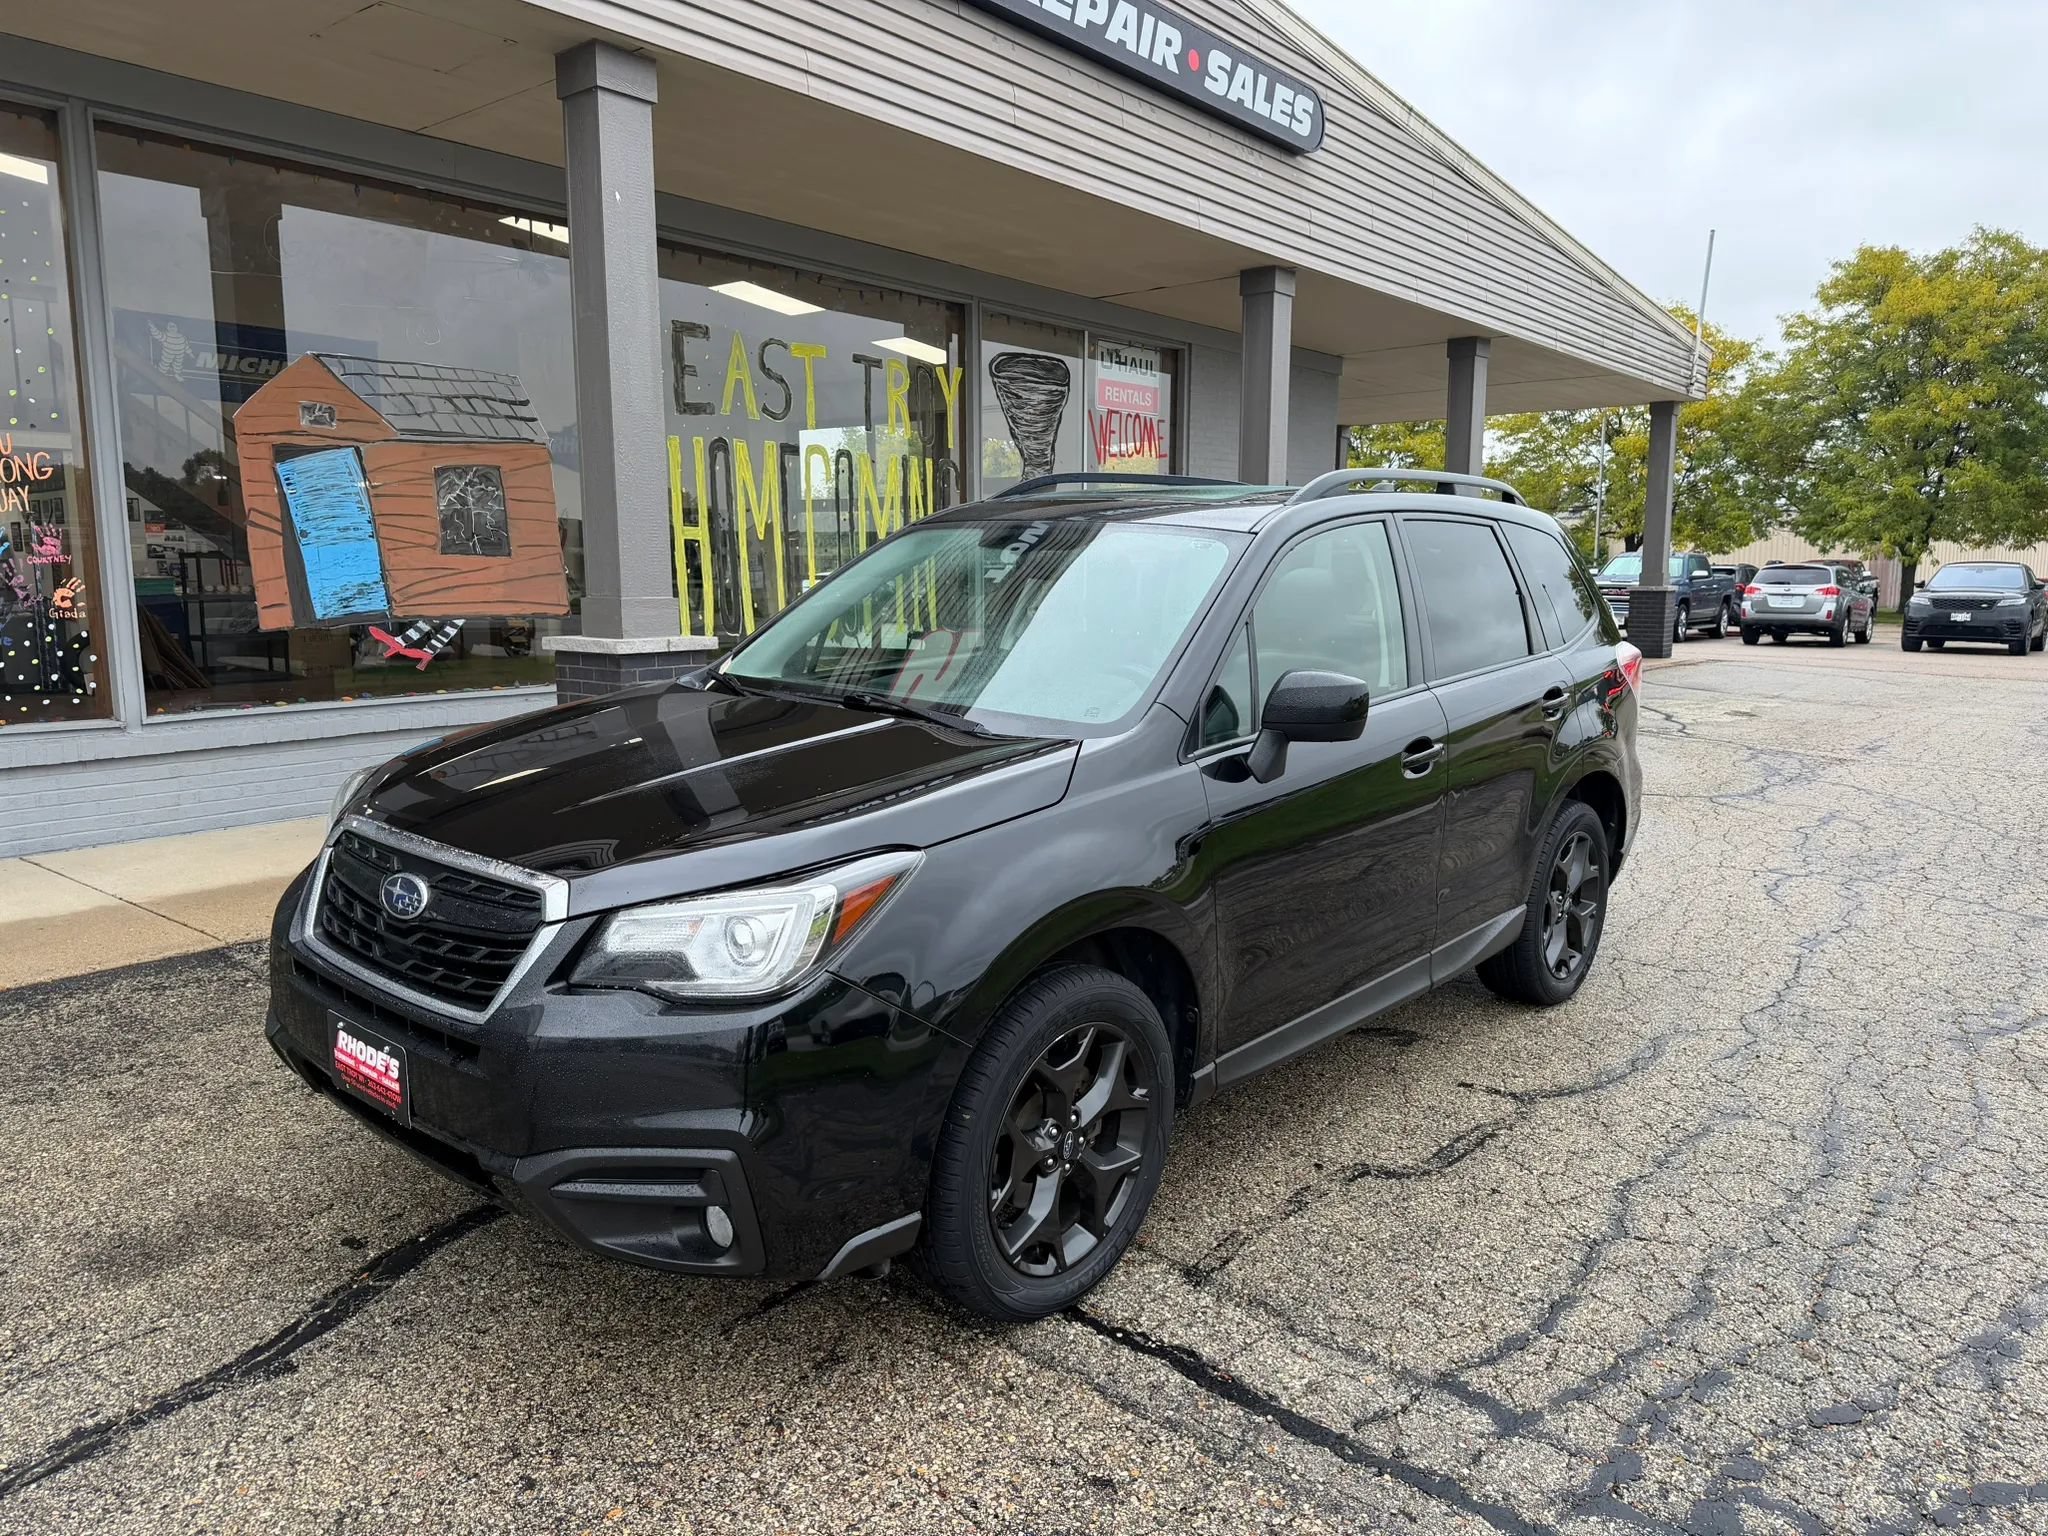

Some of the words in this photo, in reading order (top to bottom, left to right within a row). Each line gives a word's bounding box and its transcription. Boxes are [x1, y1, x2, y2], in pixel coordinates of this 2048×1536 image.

[1027, 0, 1183, 74] PAIR
[1204, 49, 1314, 137] SALES
[671, 319, 827, 430] EAST
[852, 353, 963, 449] TROY
[1105, 386, 1152, 406] RENTALS
[1088, 408, 1168, 465] WELCOME
[26, 554, 72, 565] COURTNEY
[336, 1029, 400, 1081] RHODE'S
